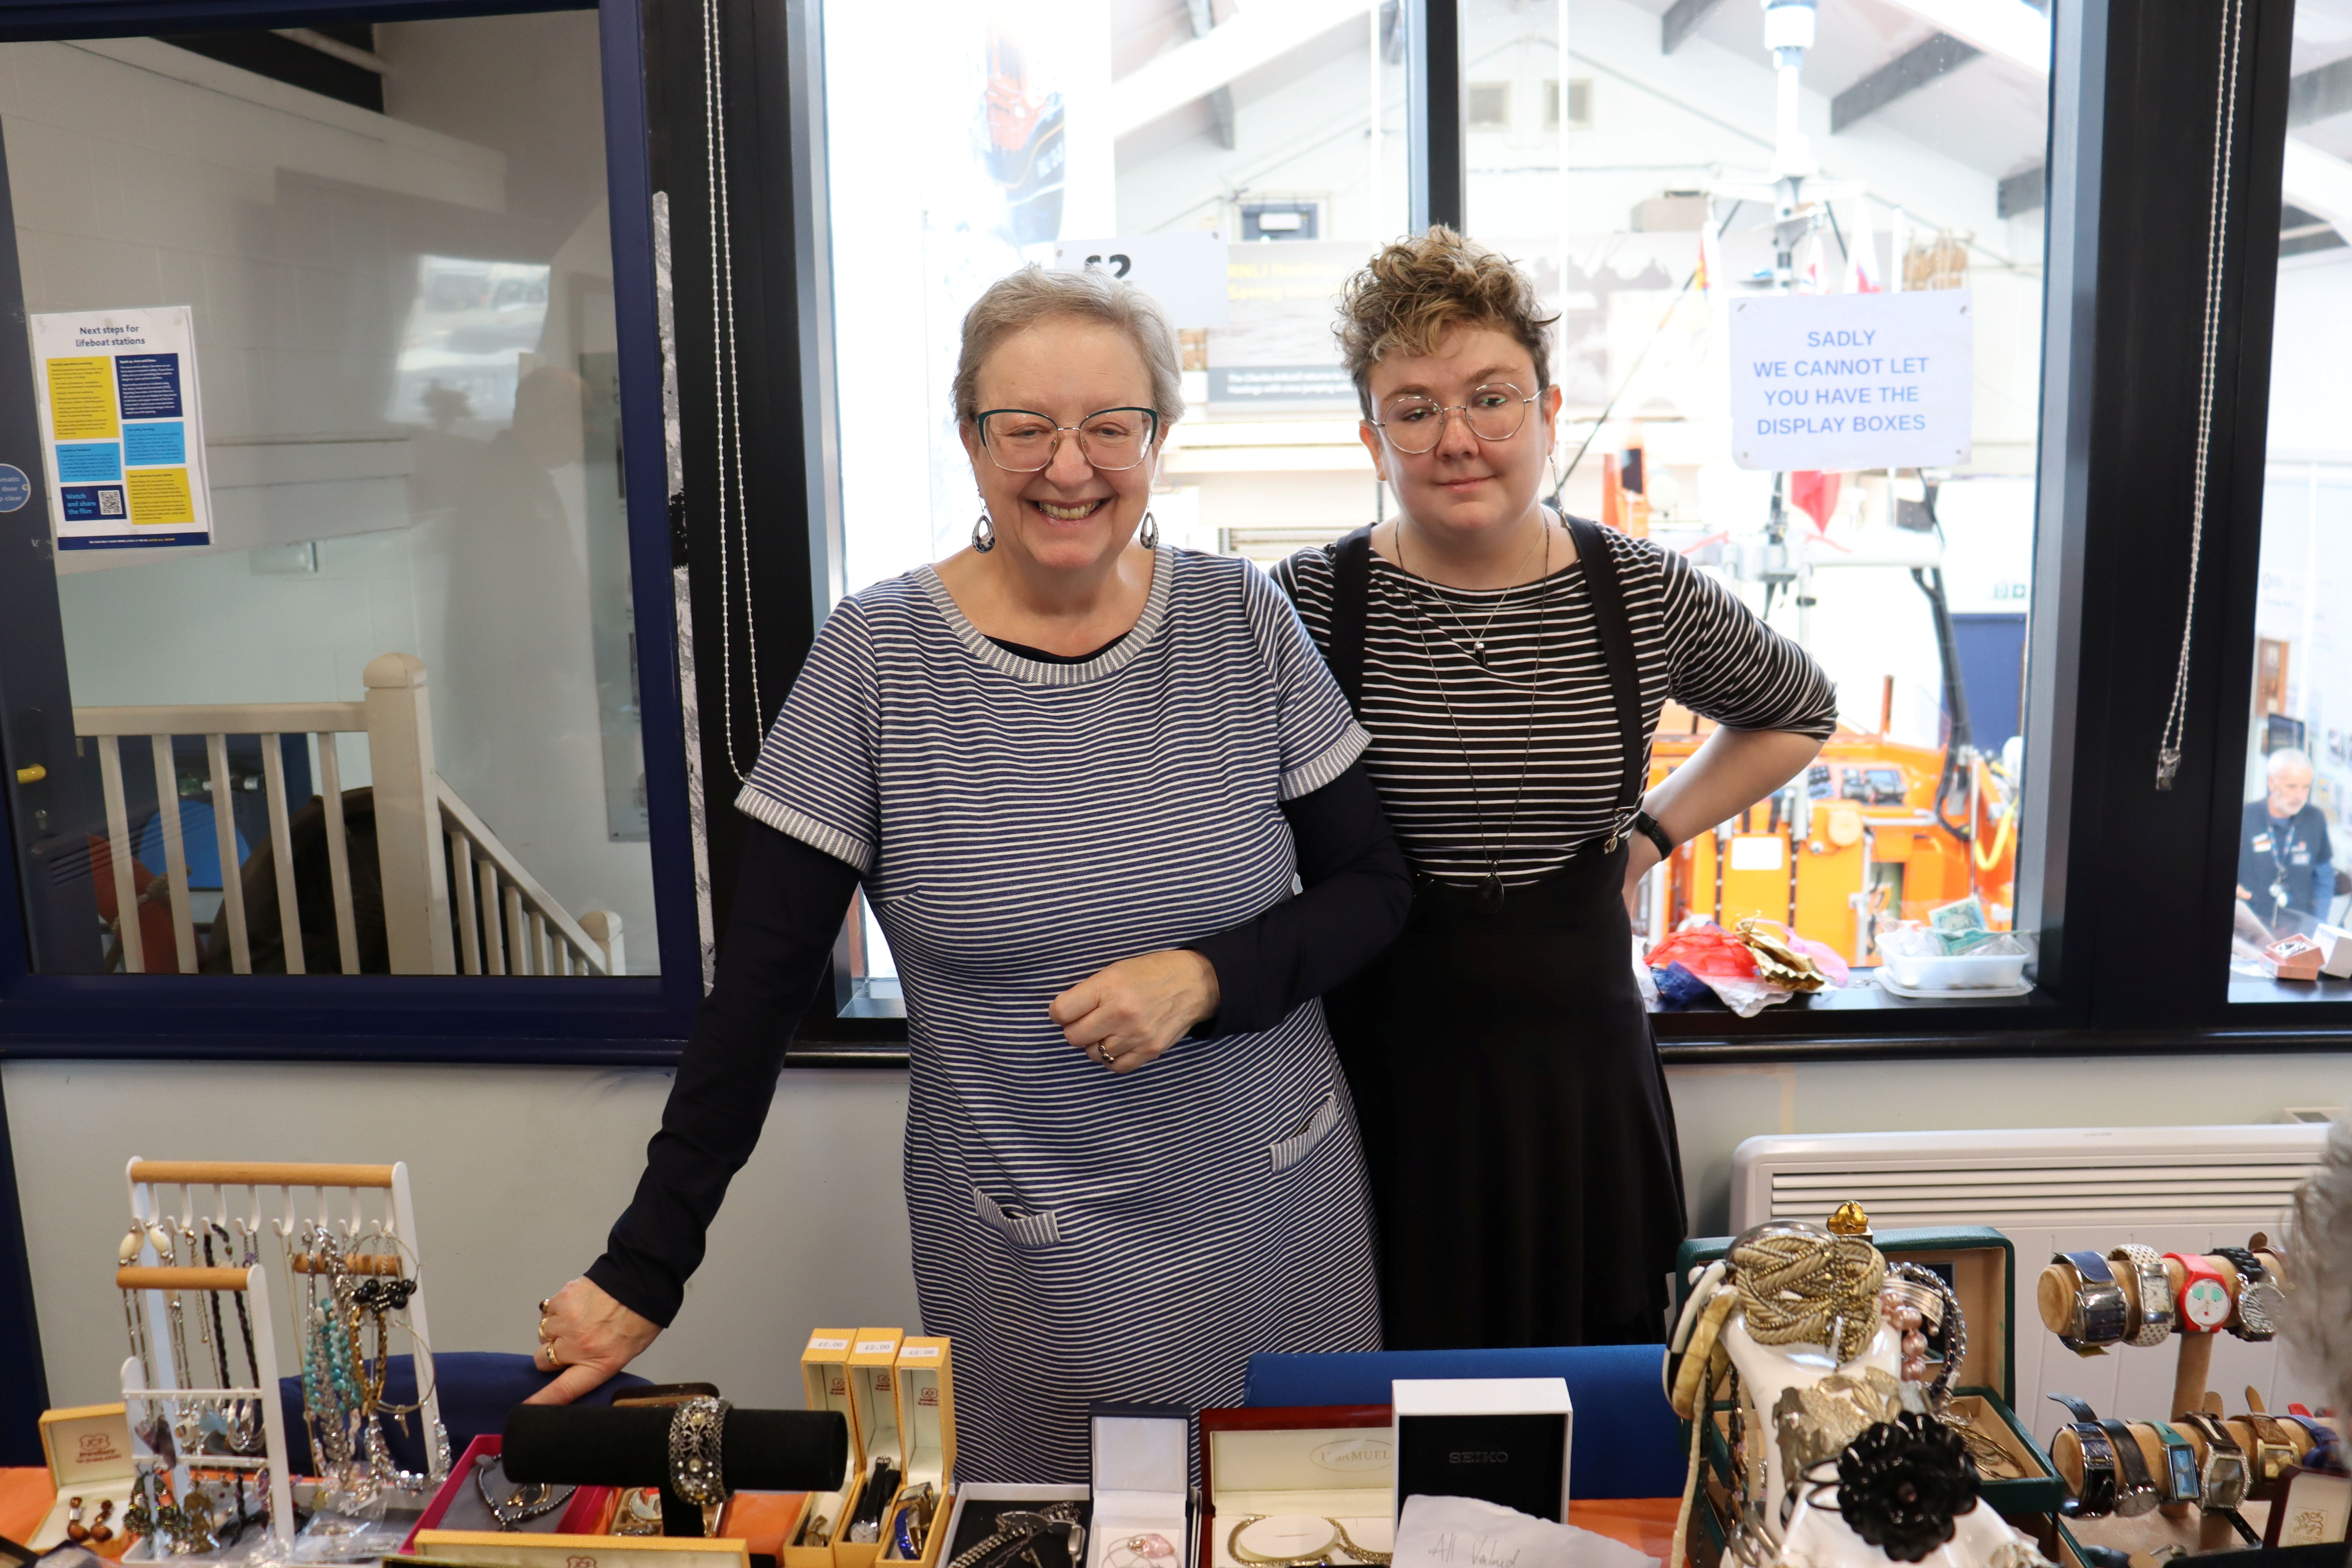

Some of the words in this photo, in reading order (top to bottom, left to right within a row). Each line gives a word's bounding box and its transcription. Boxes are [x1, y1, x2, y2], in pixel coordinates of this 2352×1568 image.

[103, 327, 124, 335] steps
[1808, 330, 1876, 347] SADLY
[76, 339, 110, 347] lifeboat
[112, 337, 145, 346] stations
[1753, 361, 1788, 377] WE
[1794, 358, 1883, 376] CANNOT
[1890, 358, 1929, 374] LET
[1764, 390, 1808, 406] YOU
[1816, 388, 1872, 404] HAVE
[1878, 386, 1919, 403] THE
[1757, 417, 1846, 435] DISPLAY
[1853, 414, 1926, 432] BOXES
[1449, 1452, 1509, 1464] SEIKO
[1428, 1533, 1457, 1563] All
